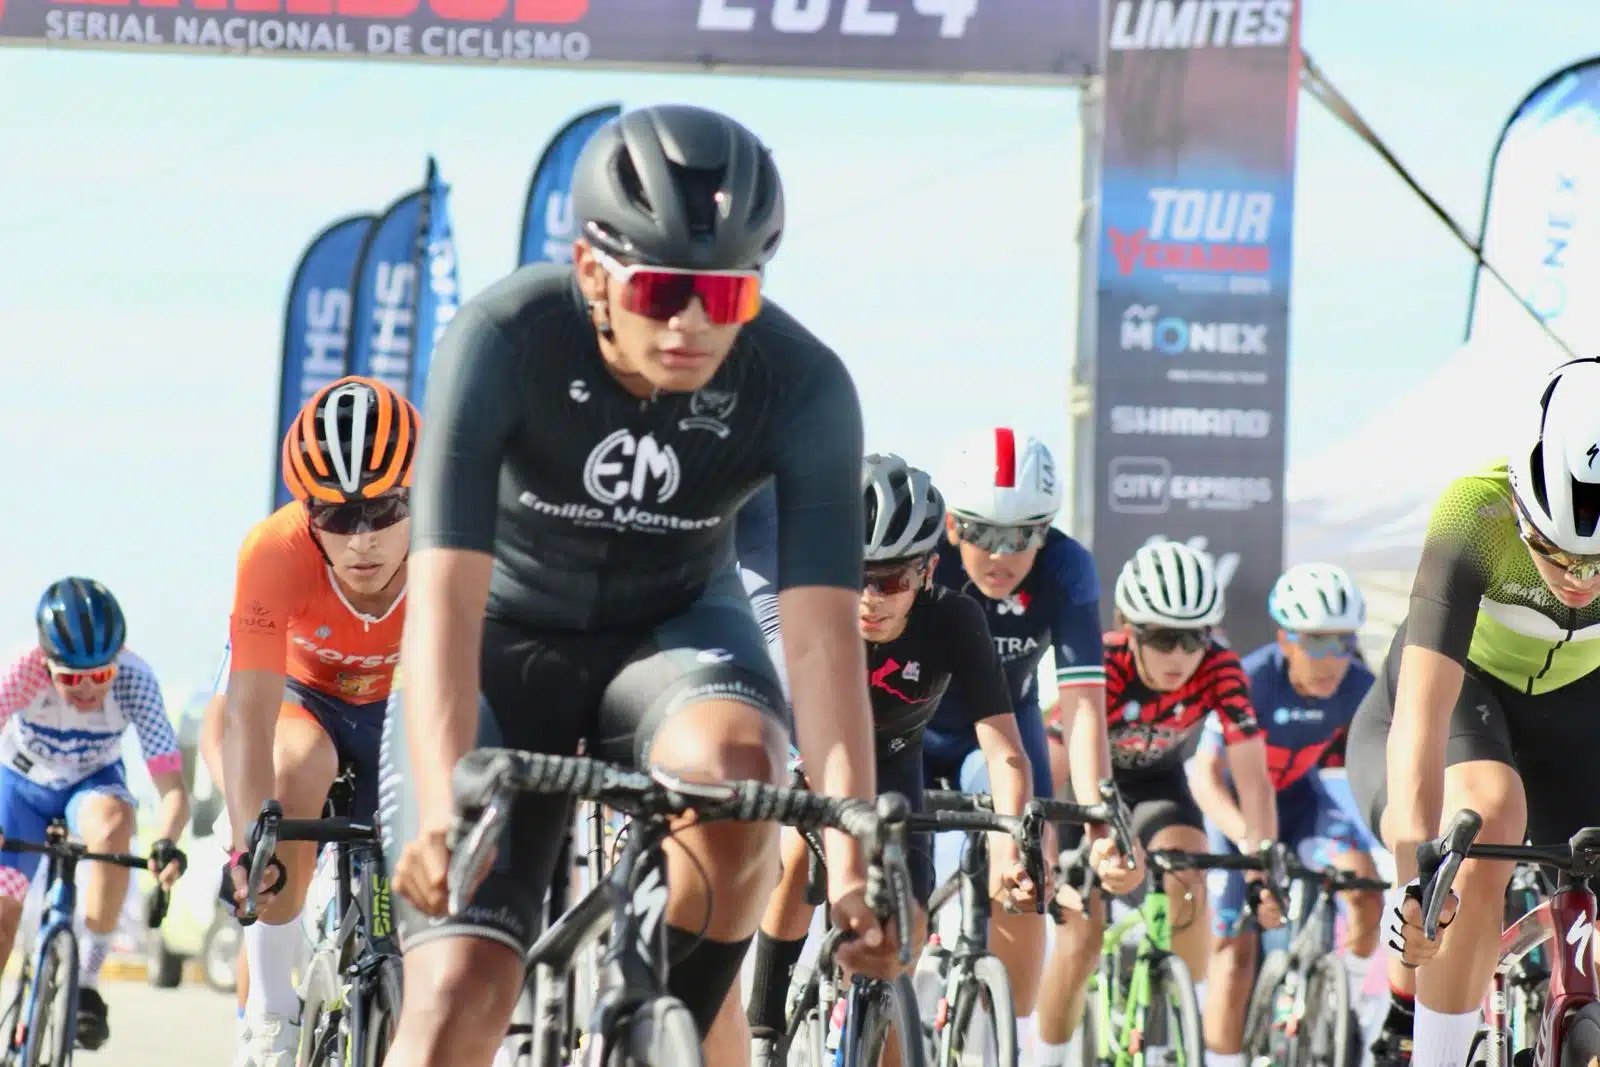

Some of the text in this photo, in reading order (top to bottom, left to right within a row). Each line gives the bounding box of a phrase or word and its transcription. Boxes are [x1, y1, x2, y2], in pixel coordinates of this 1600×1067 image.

[46, 9, 164, 45] SERIAL
[174, 15, 353, 51] NACIONAL
[367, 24, 413, 55] DE
[420, 26, 591, 61] CICLISMO
[1148, 187, 1275, 243] TOUR
[1120, 316, 1268, 354] MONEX
[1110, 405, 1271, 438] SHIMANO
[1112, 474, 1165, 498] CITY
[519, 490, 721, 530] Emilio Montero
